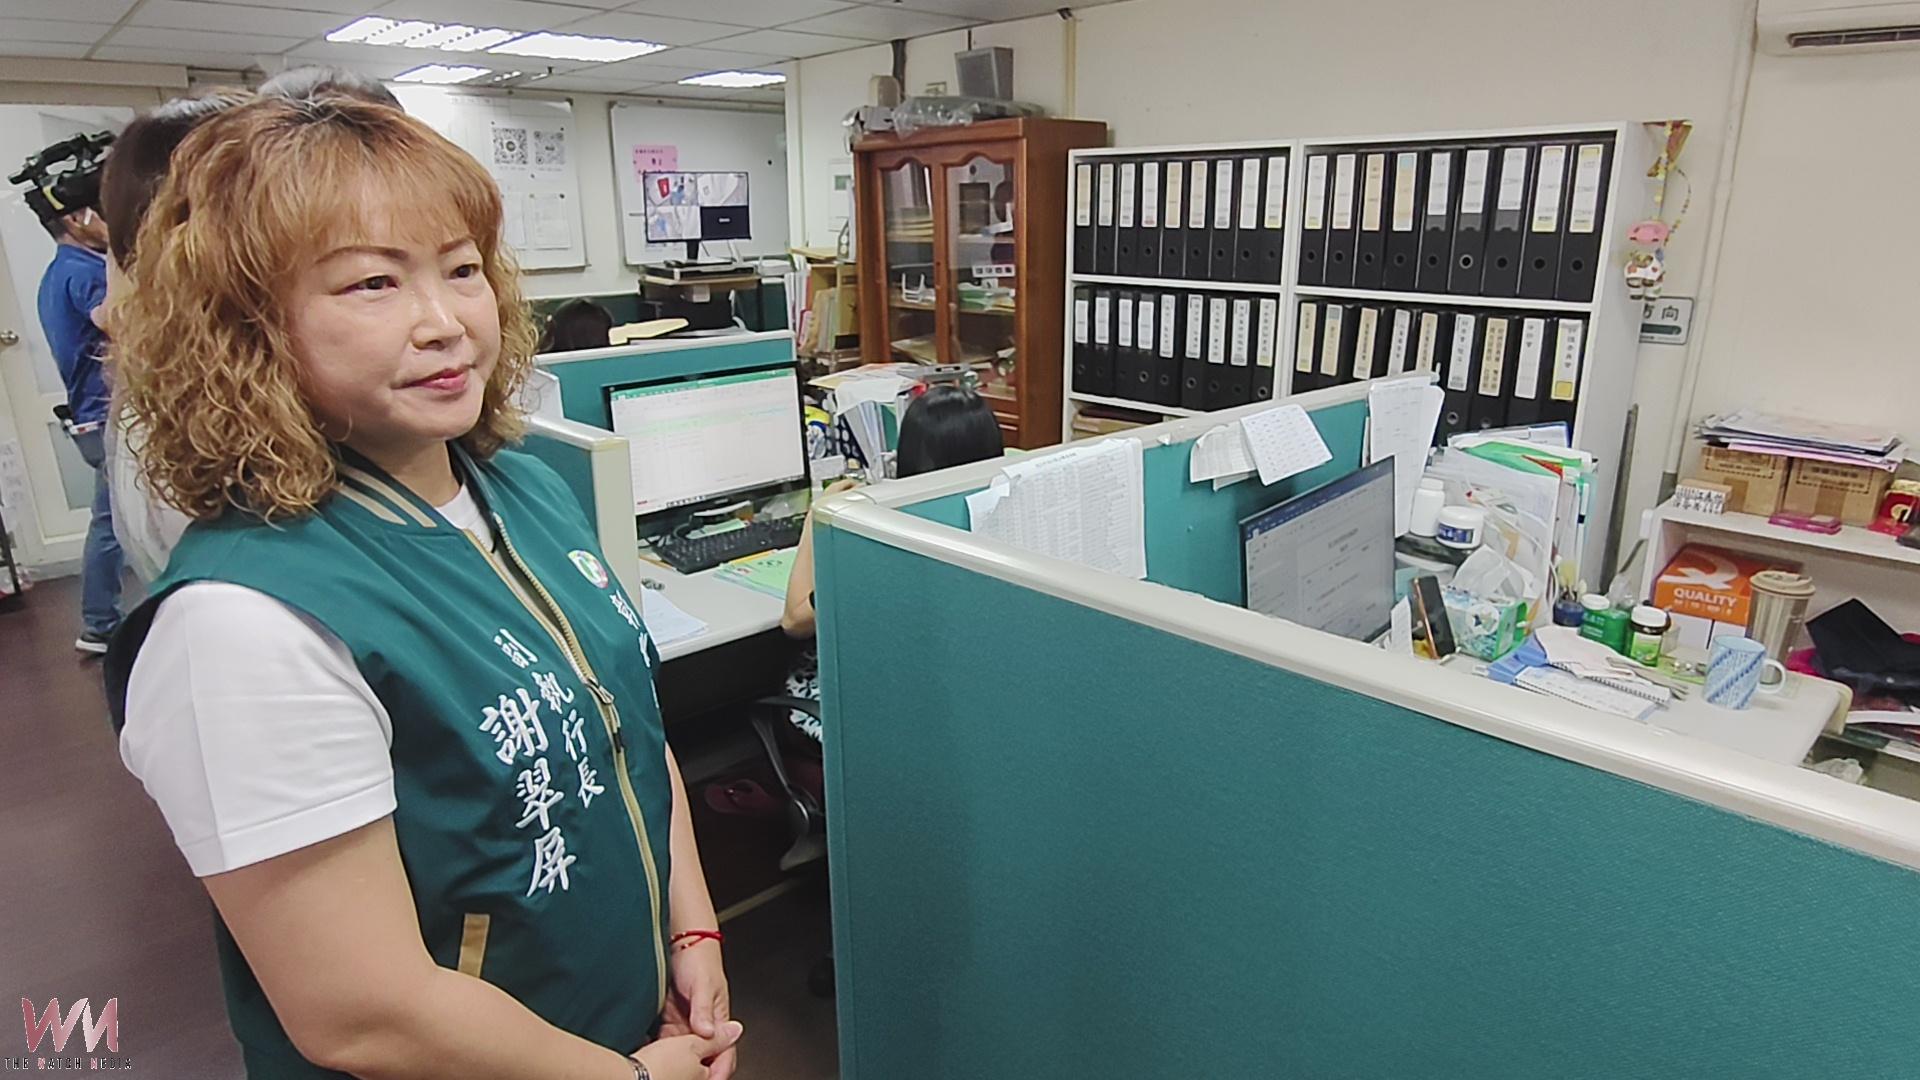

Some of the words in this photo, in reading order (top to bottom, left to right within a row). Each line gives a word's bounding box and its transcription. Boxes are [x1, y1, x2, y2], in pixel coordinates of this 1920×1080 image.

[1673, 587, 1738, 607] QUALITY
[479, 687, 577, 898] 謝翠屏
[493, 627, 606, 809] 副執行長
